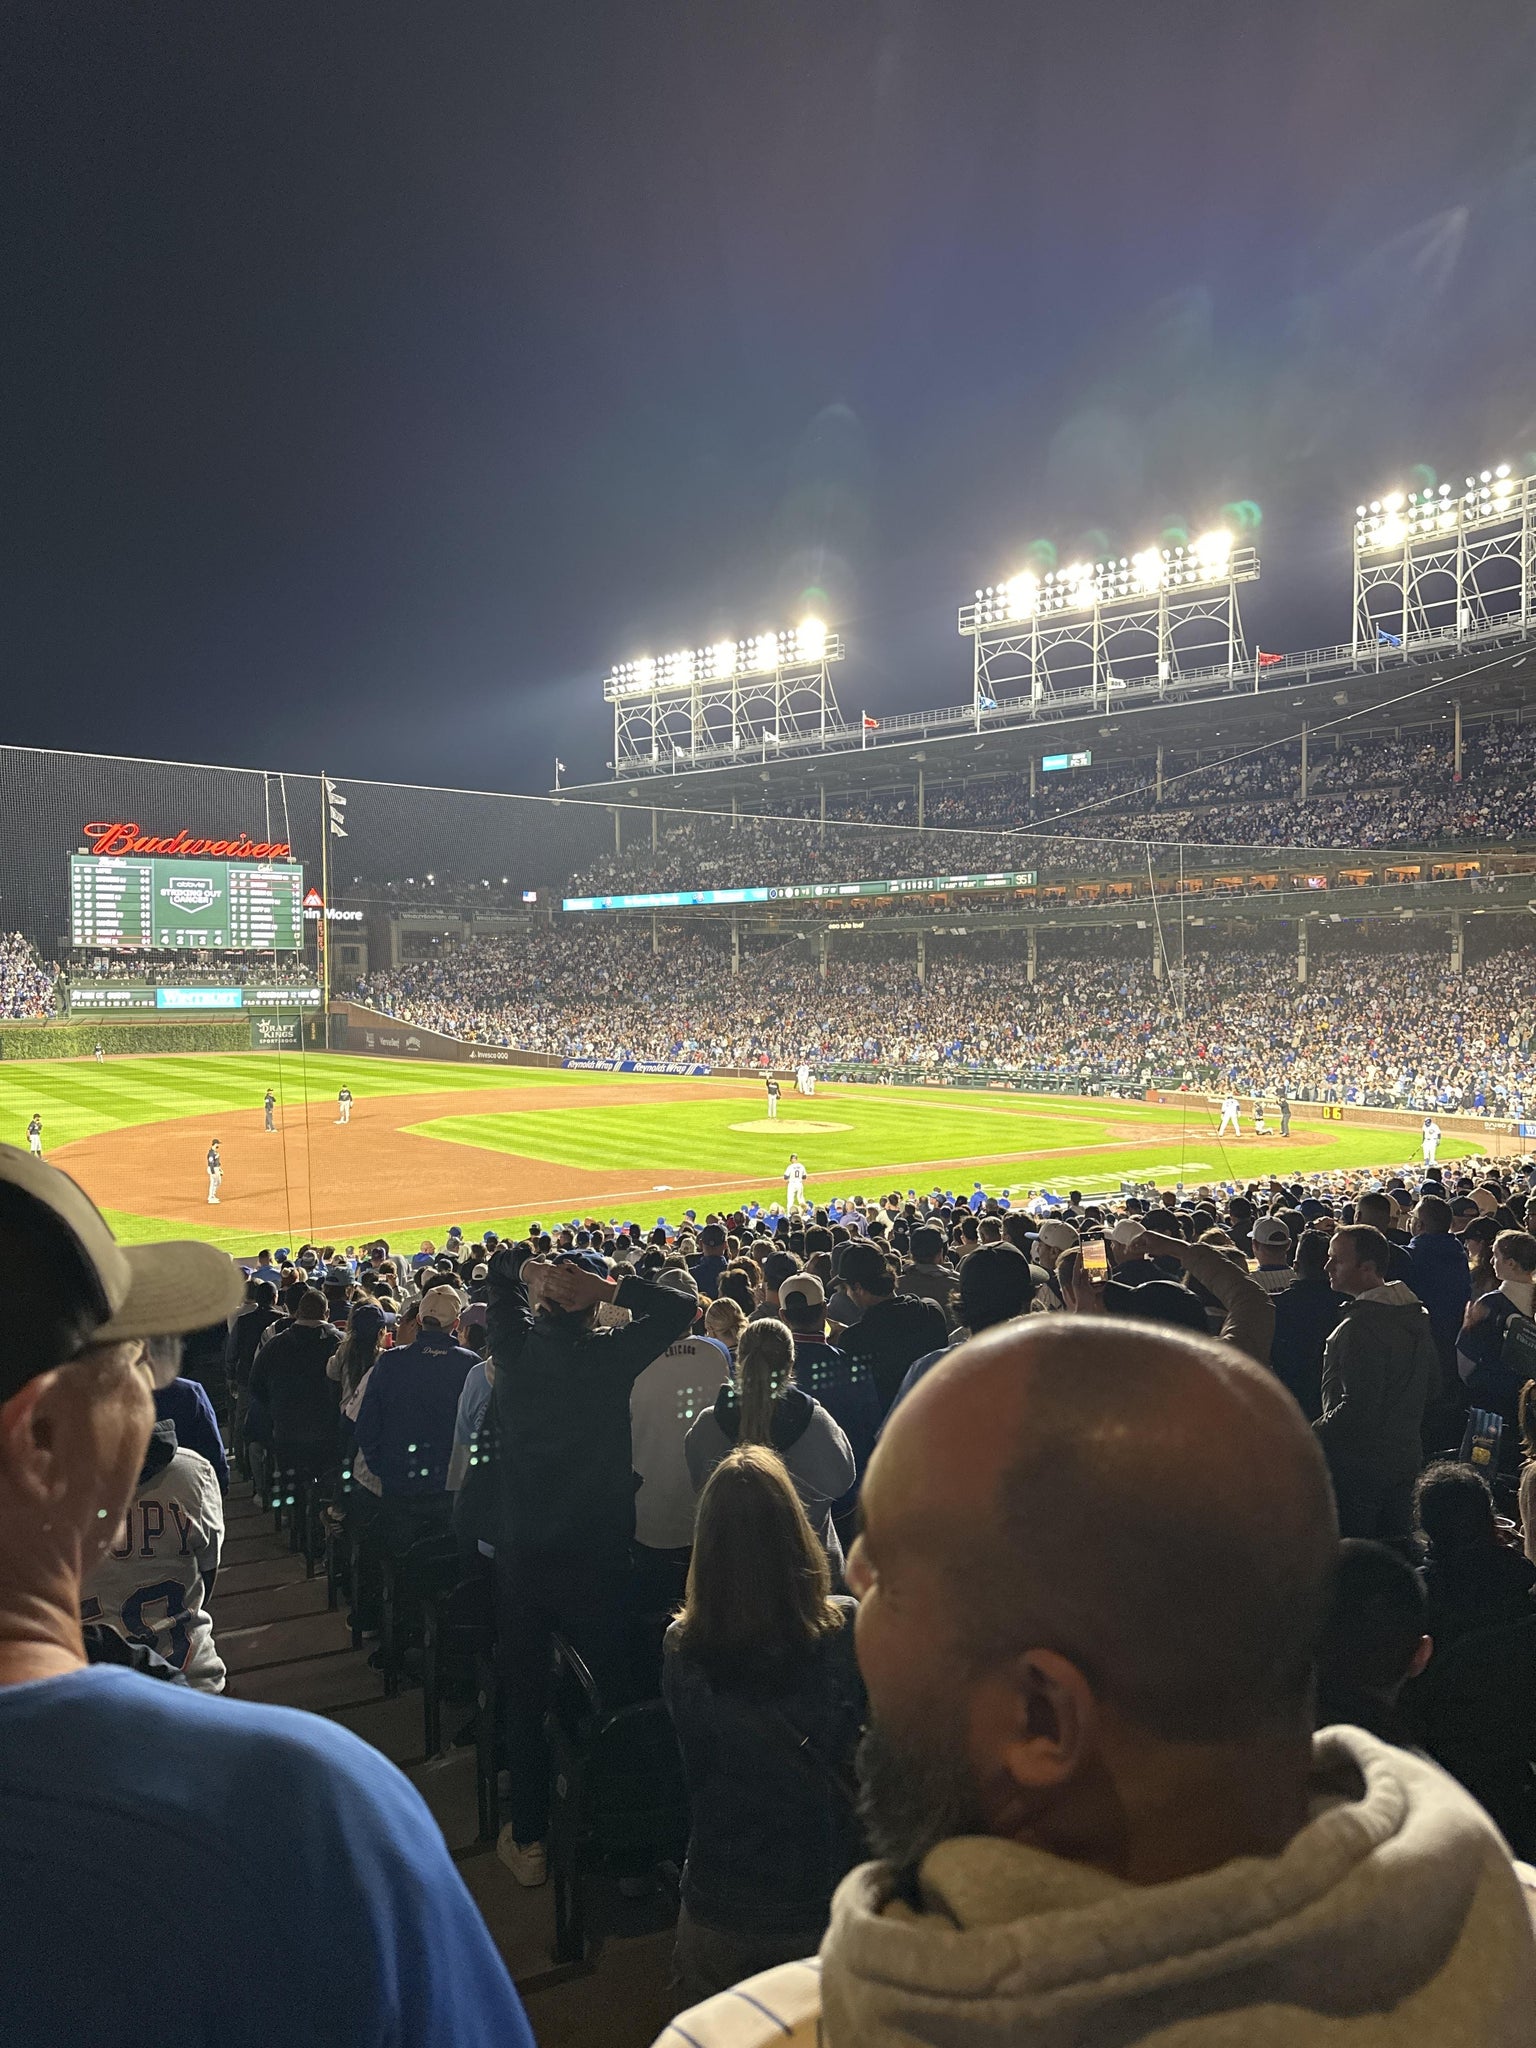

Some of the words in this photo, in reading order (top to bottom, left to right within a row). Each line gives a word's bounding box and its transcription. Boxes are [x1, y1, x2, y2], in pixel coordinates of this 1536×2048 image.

[83, 822, 291, 858] Budweiser
[203, 889, 222, 899] OUT
[324, 908, 363, 920] Moore
[258, 1023, 296, 1034] DRAFT
[263, 1031, 295, 1039] KINGS
[567, 1059, 595, 1070] Reynolds
[594, 1060, 614, 1072] Wrap
[632, 1062, 666, 1074] Reynolds
[665, 1063, 688, 1075] Wrap
